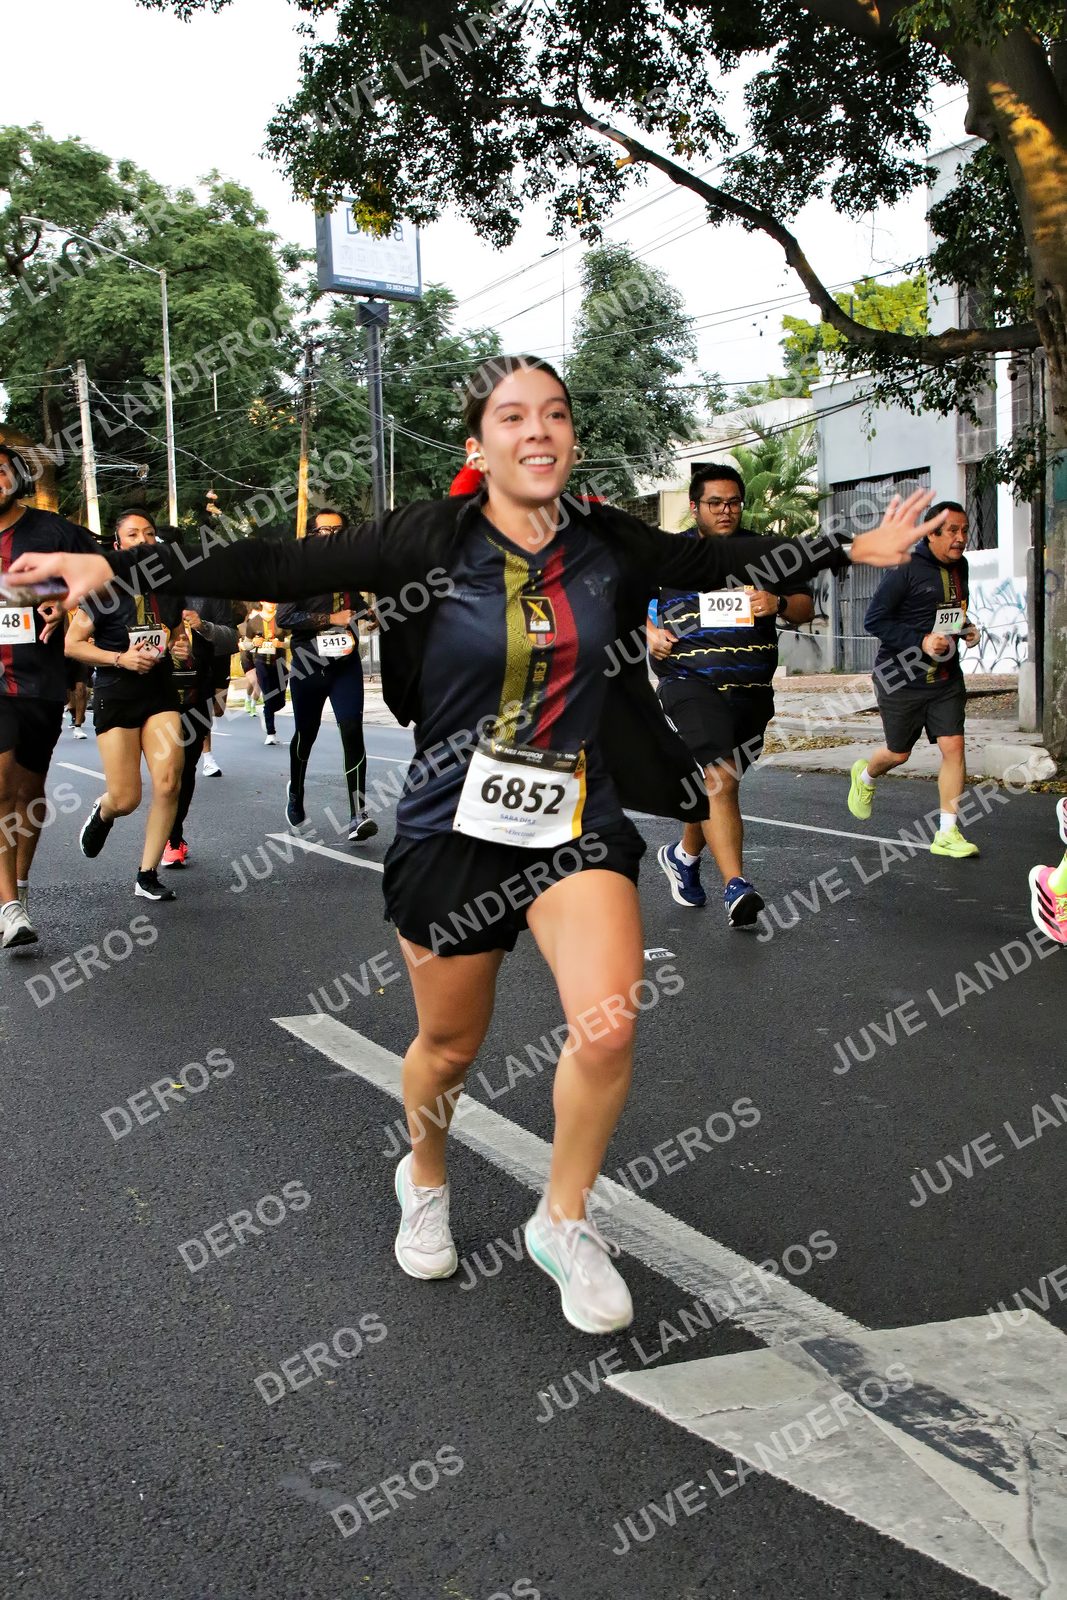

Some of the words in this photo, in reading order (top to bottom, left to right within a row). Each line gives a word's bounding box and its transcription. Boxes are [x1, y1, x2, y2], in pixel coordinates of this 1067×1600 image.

[707, 597, 743, 612] 2092
[1, 613, 21, 629] 48
[939, 611, 960, 624] 5917
[322, 636, 347, 648] 5415
[480, 773, 566, 815] 6852
